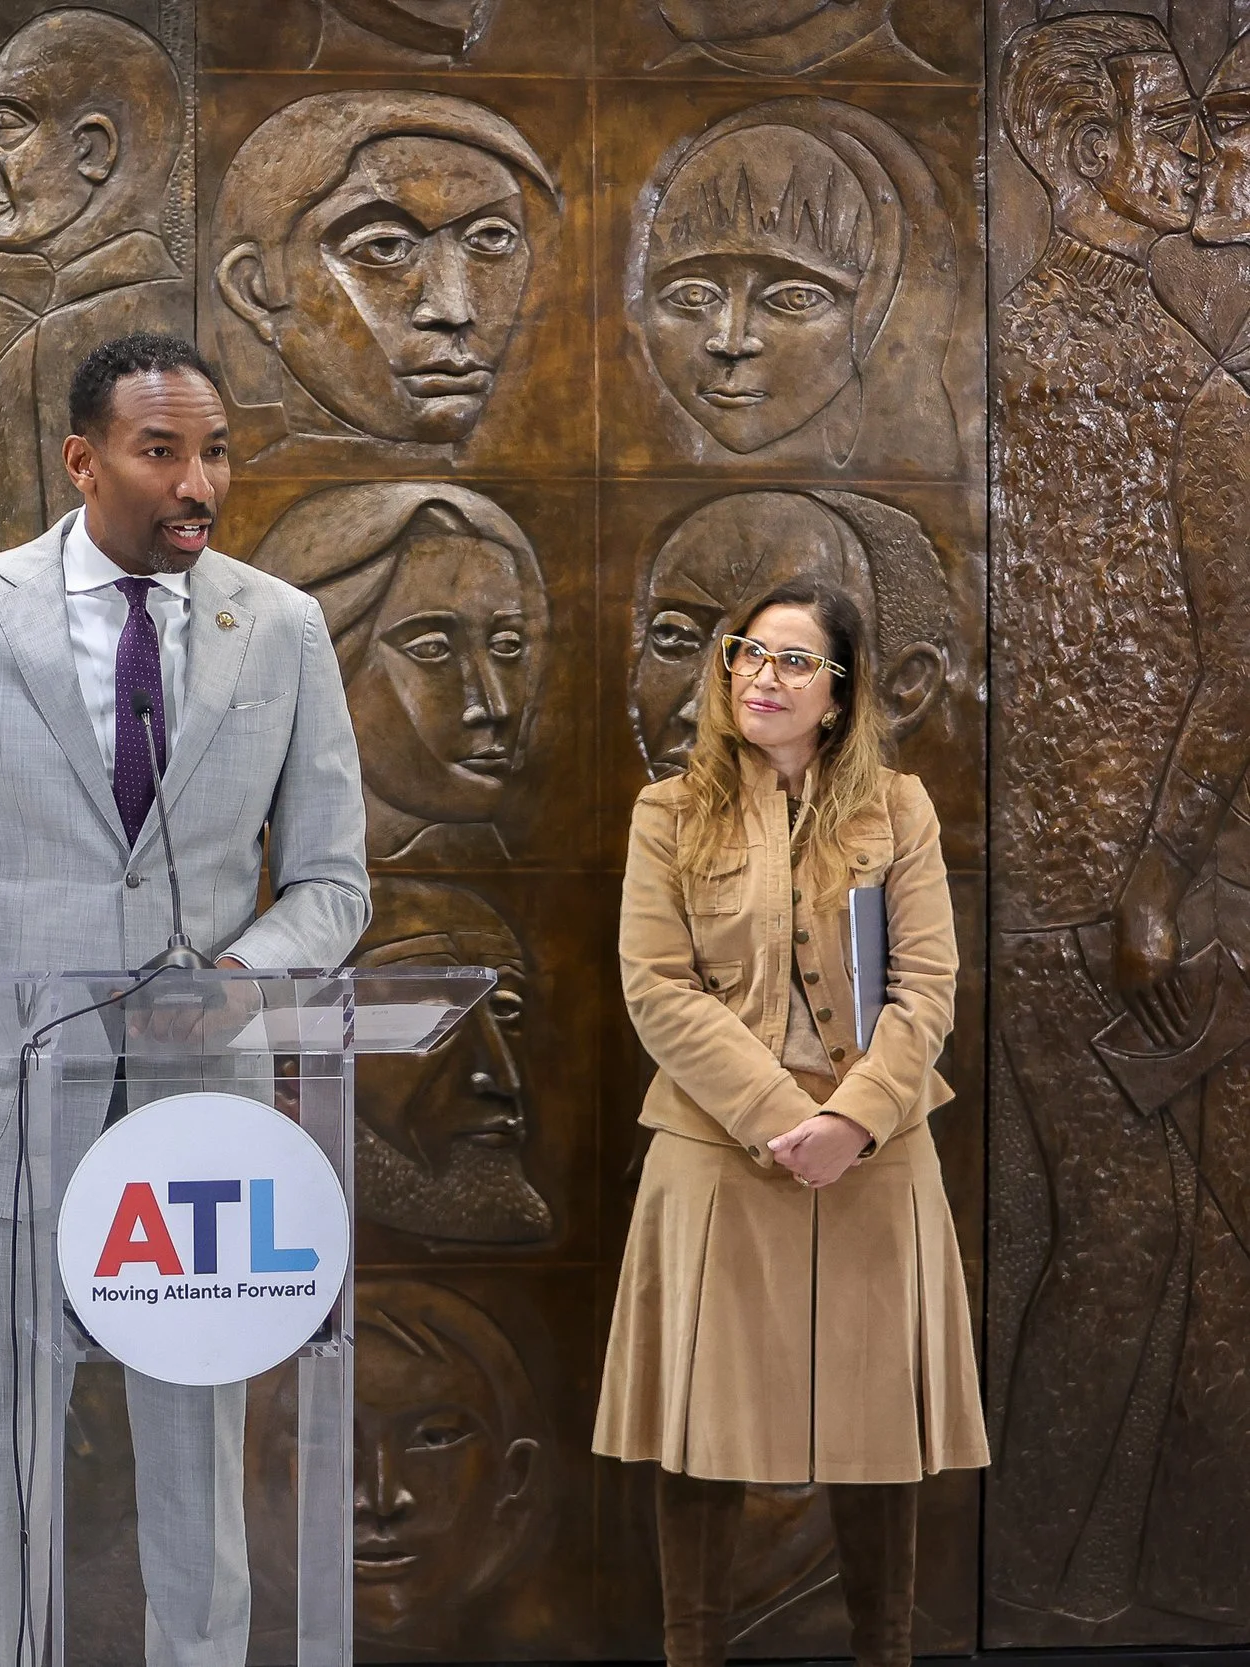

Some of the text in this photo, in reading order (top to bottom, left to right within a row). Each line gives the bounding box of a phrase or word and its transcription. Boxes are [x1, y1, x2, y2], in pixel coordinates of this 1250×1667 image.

[94, 1178, 321, 1277] ATL
[92, 1279, 316, 1304] Moving Atlanta Forward
